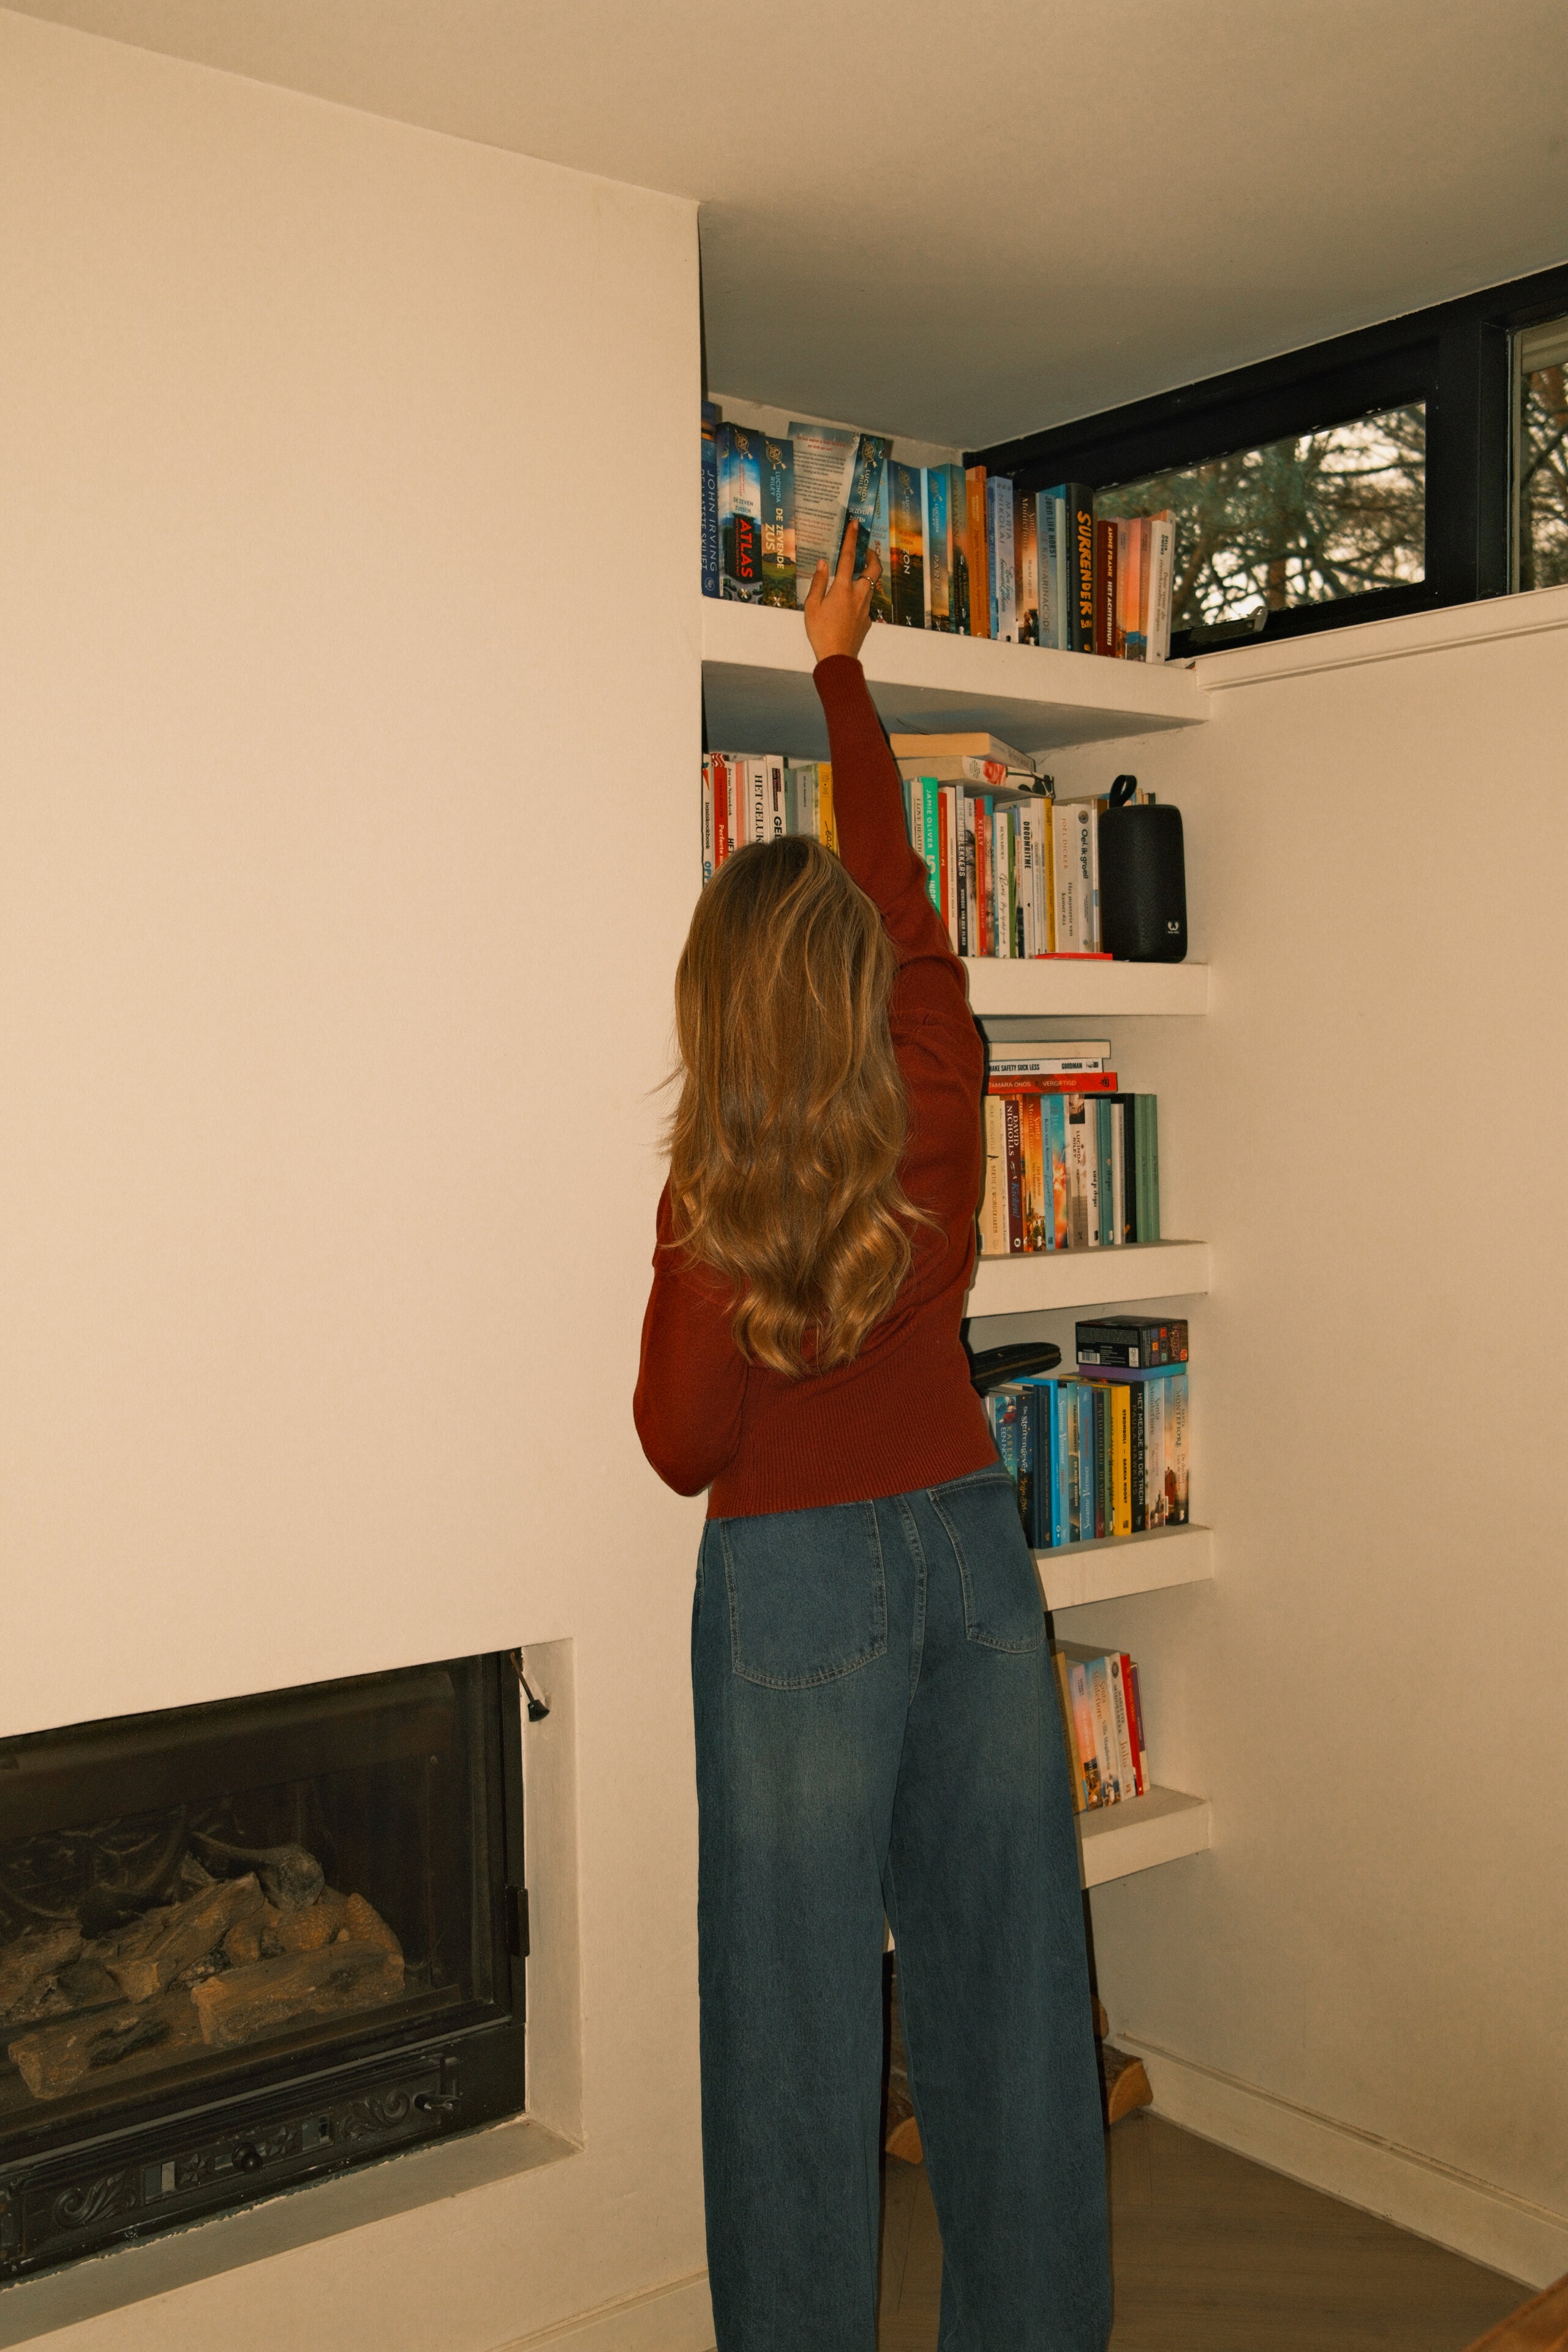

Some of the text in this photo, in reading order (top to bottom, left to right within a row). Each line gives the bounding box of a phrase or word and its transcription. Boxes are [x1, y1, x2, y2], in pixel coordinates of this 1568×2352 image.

[861, 470, 870, 502] LUCINDA
[735, 505, 751, 513] ZUSSEN
[775, 508, 783, 522] DE
[740, 519, 753, 578] ATLAS
[765, 522, 775, 551] ZUS
[1077, 510, 1093, 615] SURRENDER
[957, 799, 965, 876] DECEMBERLEKKERS
[1023, 821, 1031, 869] DROOMRITME
[926, 855, 936, 874] 5
[1138, 1450, 1143, 1460] IN
[1138, 1463, 1144, 1476] DE
[1120, 1741, 1129, 1768] Julia
